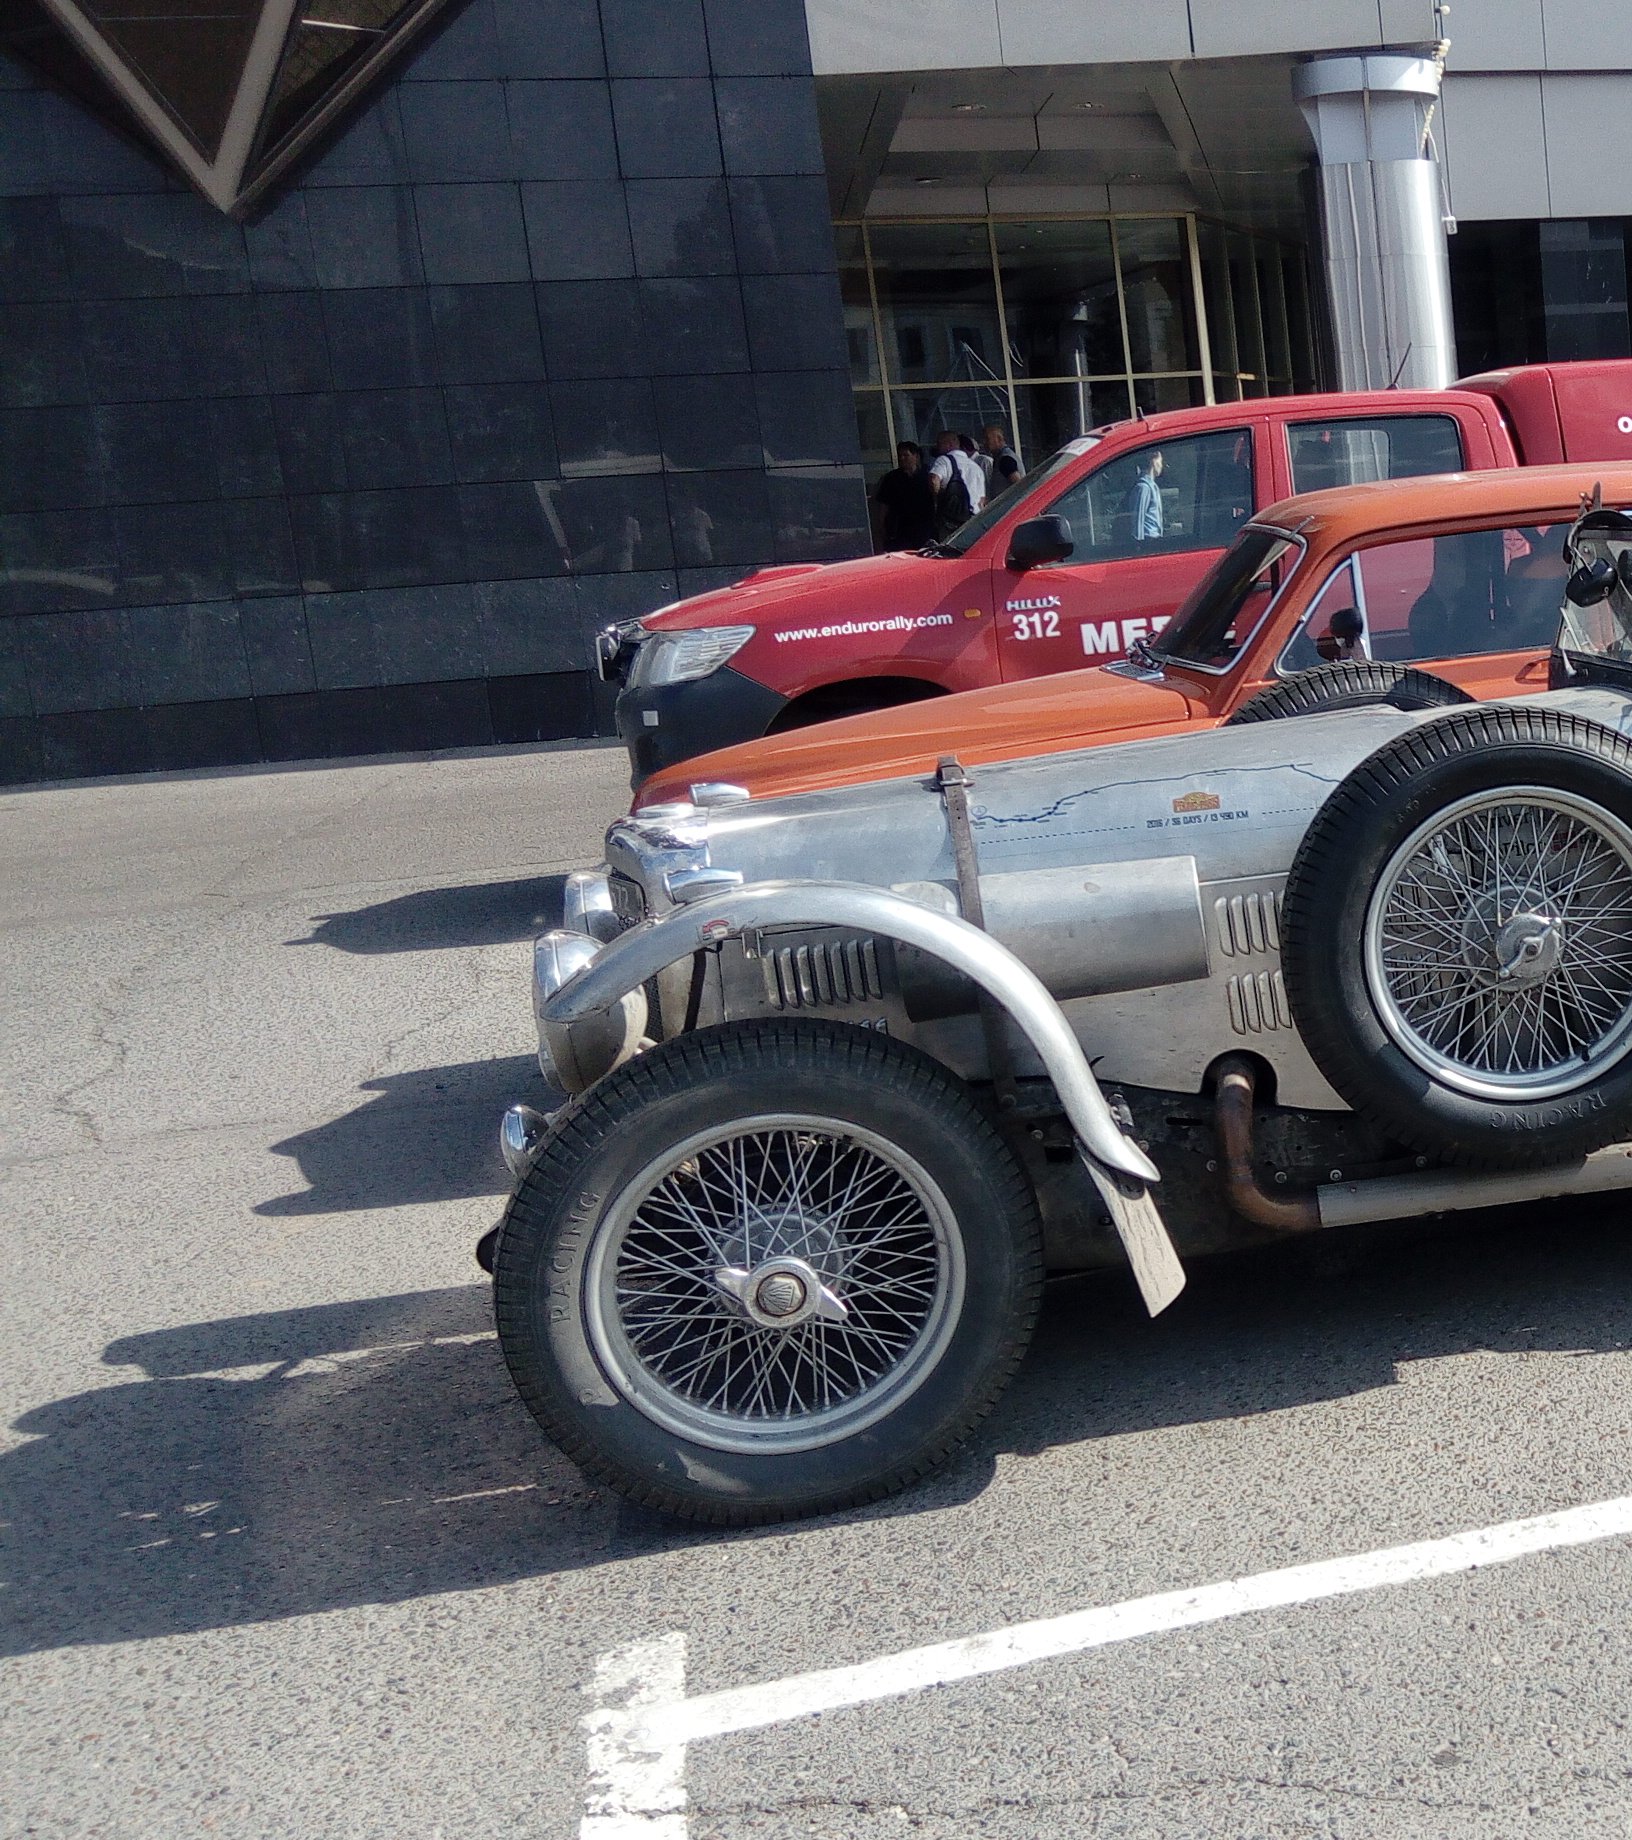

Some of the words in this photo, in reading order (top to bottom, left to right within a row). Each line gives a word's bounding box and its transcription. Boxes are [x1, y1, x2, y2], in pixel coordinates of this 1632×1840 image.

[1006, 596, 1061, 611] HILUX
[774, 613, 953, 643] www.endurorally.com
[1012, 611, 1061, 640] 312
